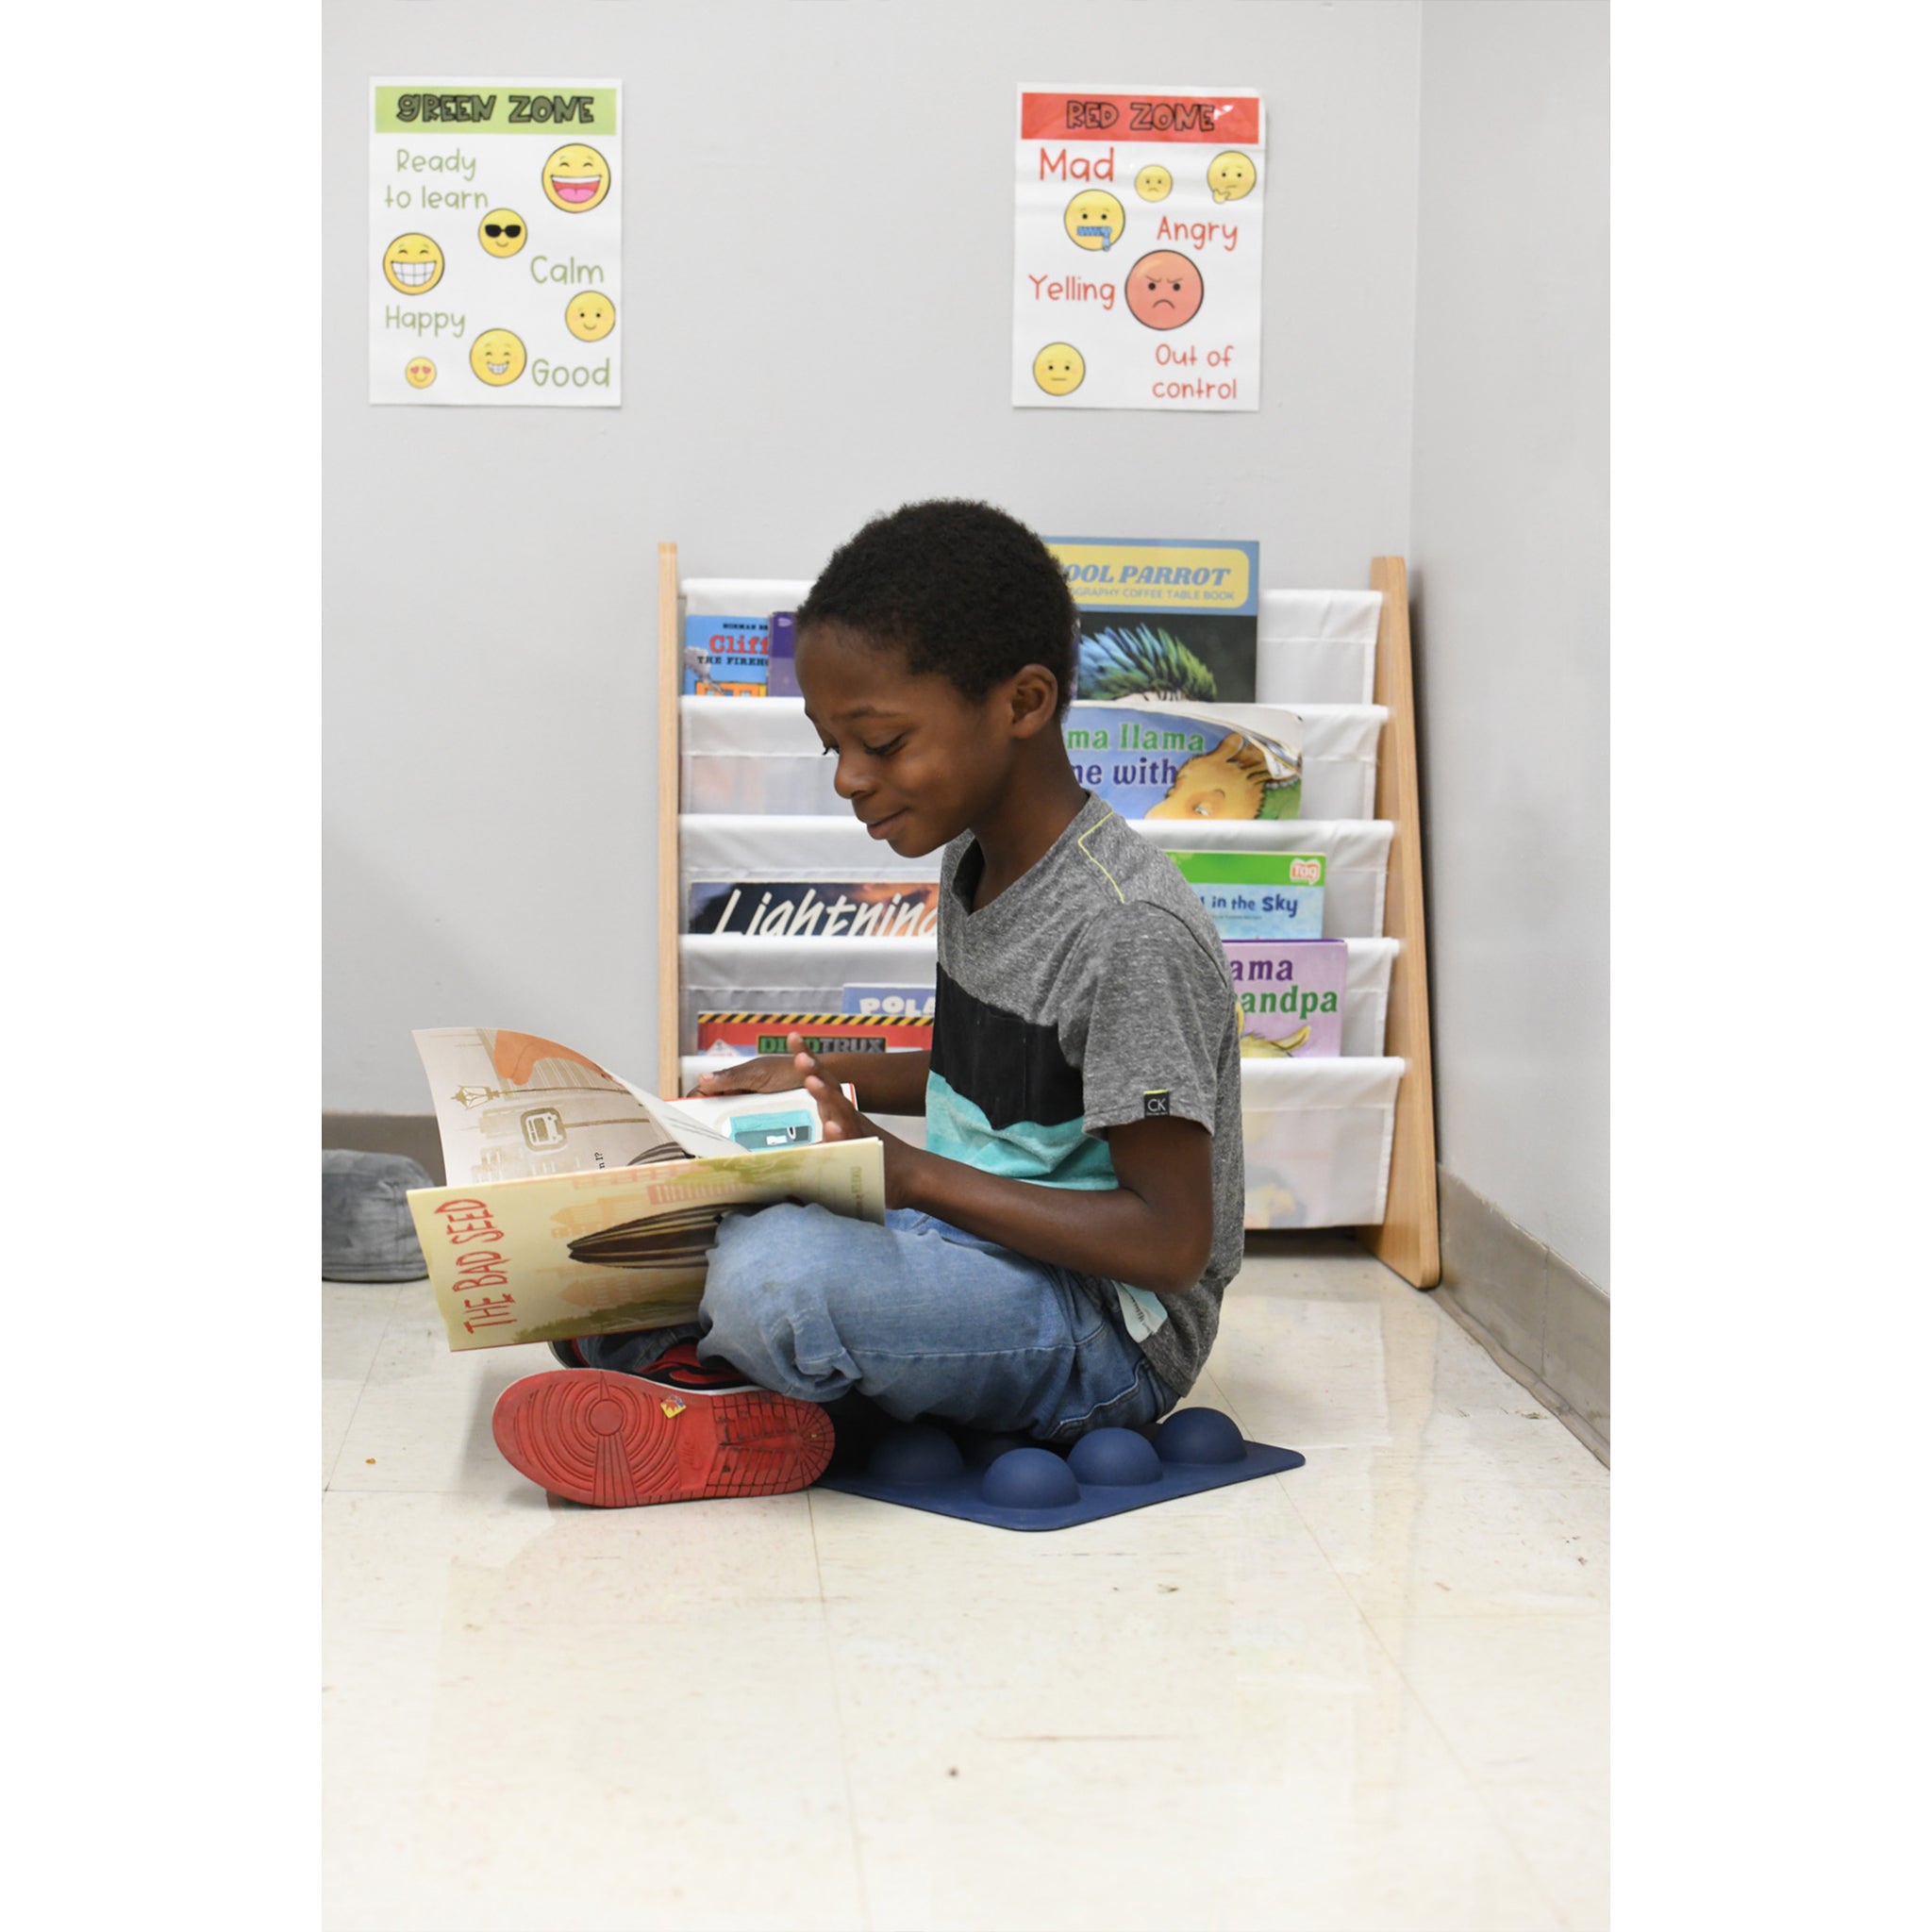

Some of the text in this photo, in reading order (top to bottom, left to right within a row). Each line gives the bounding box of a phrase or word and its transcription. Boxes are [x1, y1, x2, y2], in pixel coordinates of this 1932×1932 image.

[508, 95, 594, 124] ZONE
[1066, 100, 1215, 132] RED ZONE
[396, 148, 476, 181] Ready
[1040, 146, 1114, 182] Mad
[385, 185, 489, 209] to learn
[1157, 215, 1239, 251] Angry
[530, 256, 604, 285] Calm
[1028, 274, 1115, 310] Yelling
[385, 306, 466, 338] Happy
[1156, 343, 1234, 367] Out of
[531, 358, 609, 388] Good
[1153, 378, 1238, 400] control
[1119, 565, 1231, 586] PARROT
[1123, 588, 1162, 599] COFFEE
[1167, 589, 1199, 600] TABLE
[1203, 591, 1234, 601] BOOK
[697, 656, 722, 664] THE
[1119, 724, 1205, 752] llama
[1113, 757, 1178, 785] with
[1293, 864, 1318, 883] Tag
[1211, 896, 1226, 908] in
[1231, 894, 1256, 911] the
[1261, 893, 1298, 918] Sky
[1234, 985, 1338, 1020] andpa
[759, 1037, 883, 1054] DIOTRUX
[1147, 1098, 1166, 1112] CK
[434, 1199, 518, 1335] THE BAD SEED
